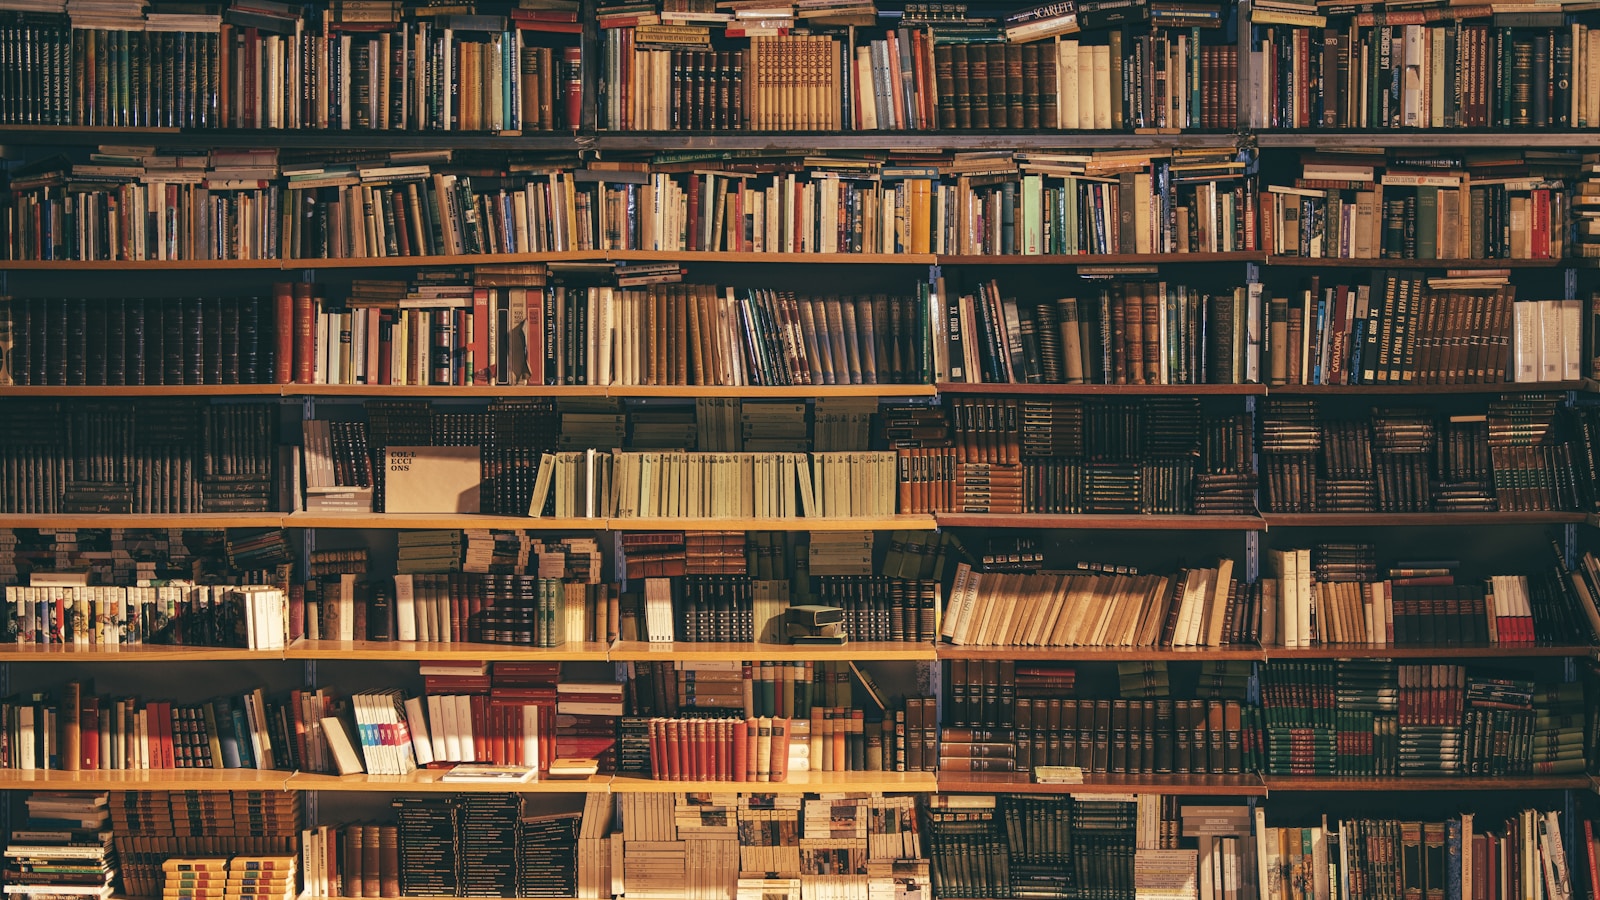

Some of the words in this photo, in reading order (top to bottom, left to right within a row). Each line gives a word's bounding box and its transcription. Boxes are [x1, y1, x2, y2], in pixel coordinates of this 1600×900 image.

[1034, 1, 1074, 20] SCARLETT
[1381, 28, 1390, 55] CIENCIAS
[1381, 57, 1389, 70] LAS
[1371, 308, 1378, 317] XX
[1385, 277, 1396, 316] EXTINGUIDAS
[1410, 280, 1421, 315] OCCIDENTAL
[1393, 336, 1402, 354] ÉPOCA
[1398, 280, 1409, 313] EXPANSIÓN
[1332, 331, 1342, 372] CATALONIA
[1380, 318, 1391, 364] CIVILIZACIONES
[1406, 317, 1417, 355] CIVILIZACIÓN
[953, 569, 967, 603] PARNASO
[963, 577, 977, 612] PARNASO
